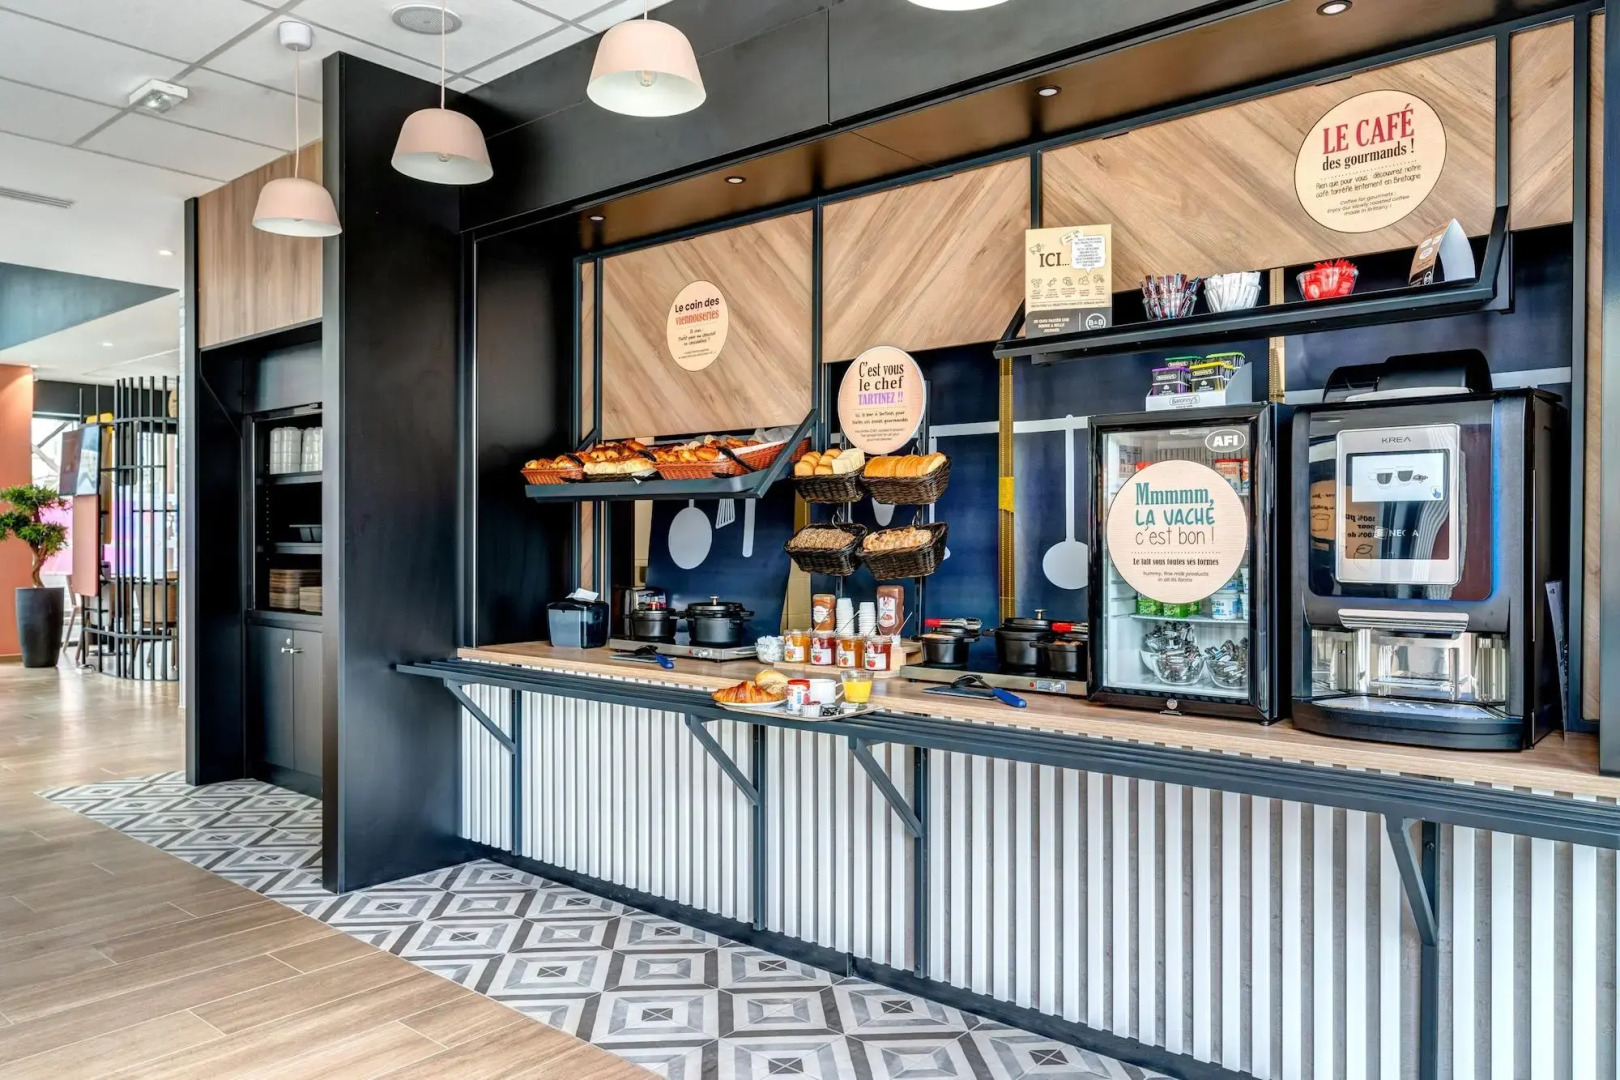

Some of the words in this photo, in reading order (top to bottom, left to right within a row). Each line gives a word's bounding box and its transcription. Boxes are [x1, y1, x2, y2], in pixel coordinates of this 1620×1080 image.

[1322, 123, 1349, 154] LE
[1356, 103, 1415, 147] CAFÉ
[1322, 156, 1341, 171] des
[1344, 140, 1407, 170] gourmands
[1316, 182, 1328, 190] Rien
[1329, 180, 1339, 188] que
[1340, 178, 1352, 188] pour
[1373, 167, 1403, 179] découvrez
[1404, 164, 1421, 173] notre
[1316, 190, 1329, 198] café
[1331, 184, 1353, 195] torréfié
[1354, 180, 1382, 191] lentement
[1393, 174, 1421, 184] Bretagne
[675, 304, 684, 313] Le
[685, 299, 703, 311] coin
[704, 297, 719, 307] des
[859, 361, 880, 378] C'est
[883, 363, 904, 376] vous
[859, 379, 870, 391] le
[874, 376, 904, 390] chef
[858, 392, 895, 405] TARTINEZ
[1213, 435, 1238, 447] AFI
[1381, 436, 1412, 444] KREA
[1135, 482, 1214, 507] Mmmmm,
[1136, 509, 1156, 526] LA
[1163, 507, 1215, 526] VACHE
[1135, 526, 1172, 545] c'est
[1178, 526, 1205, 545] bon
[1133, 558, 1140, 566] Le
[1141, 558, 1151, 566] lait
[1152, 558, 1166, 566] sous
[1167, 558, 1185, 566] toutes
[1186, 558, 1196, 566] ses
[1197, 558, 1219, 566] formes
